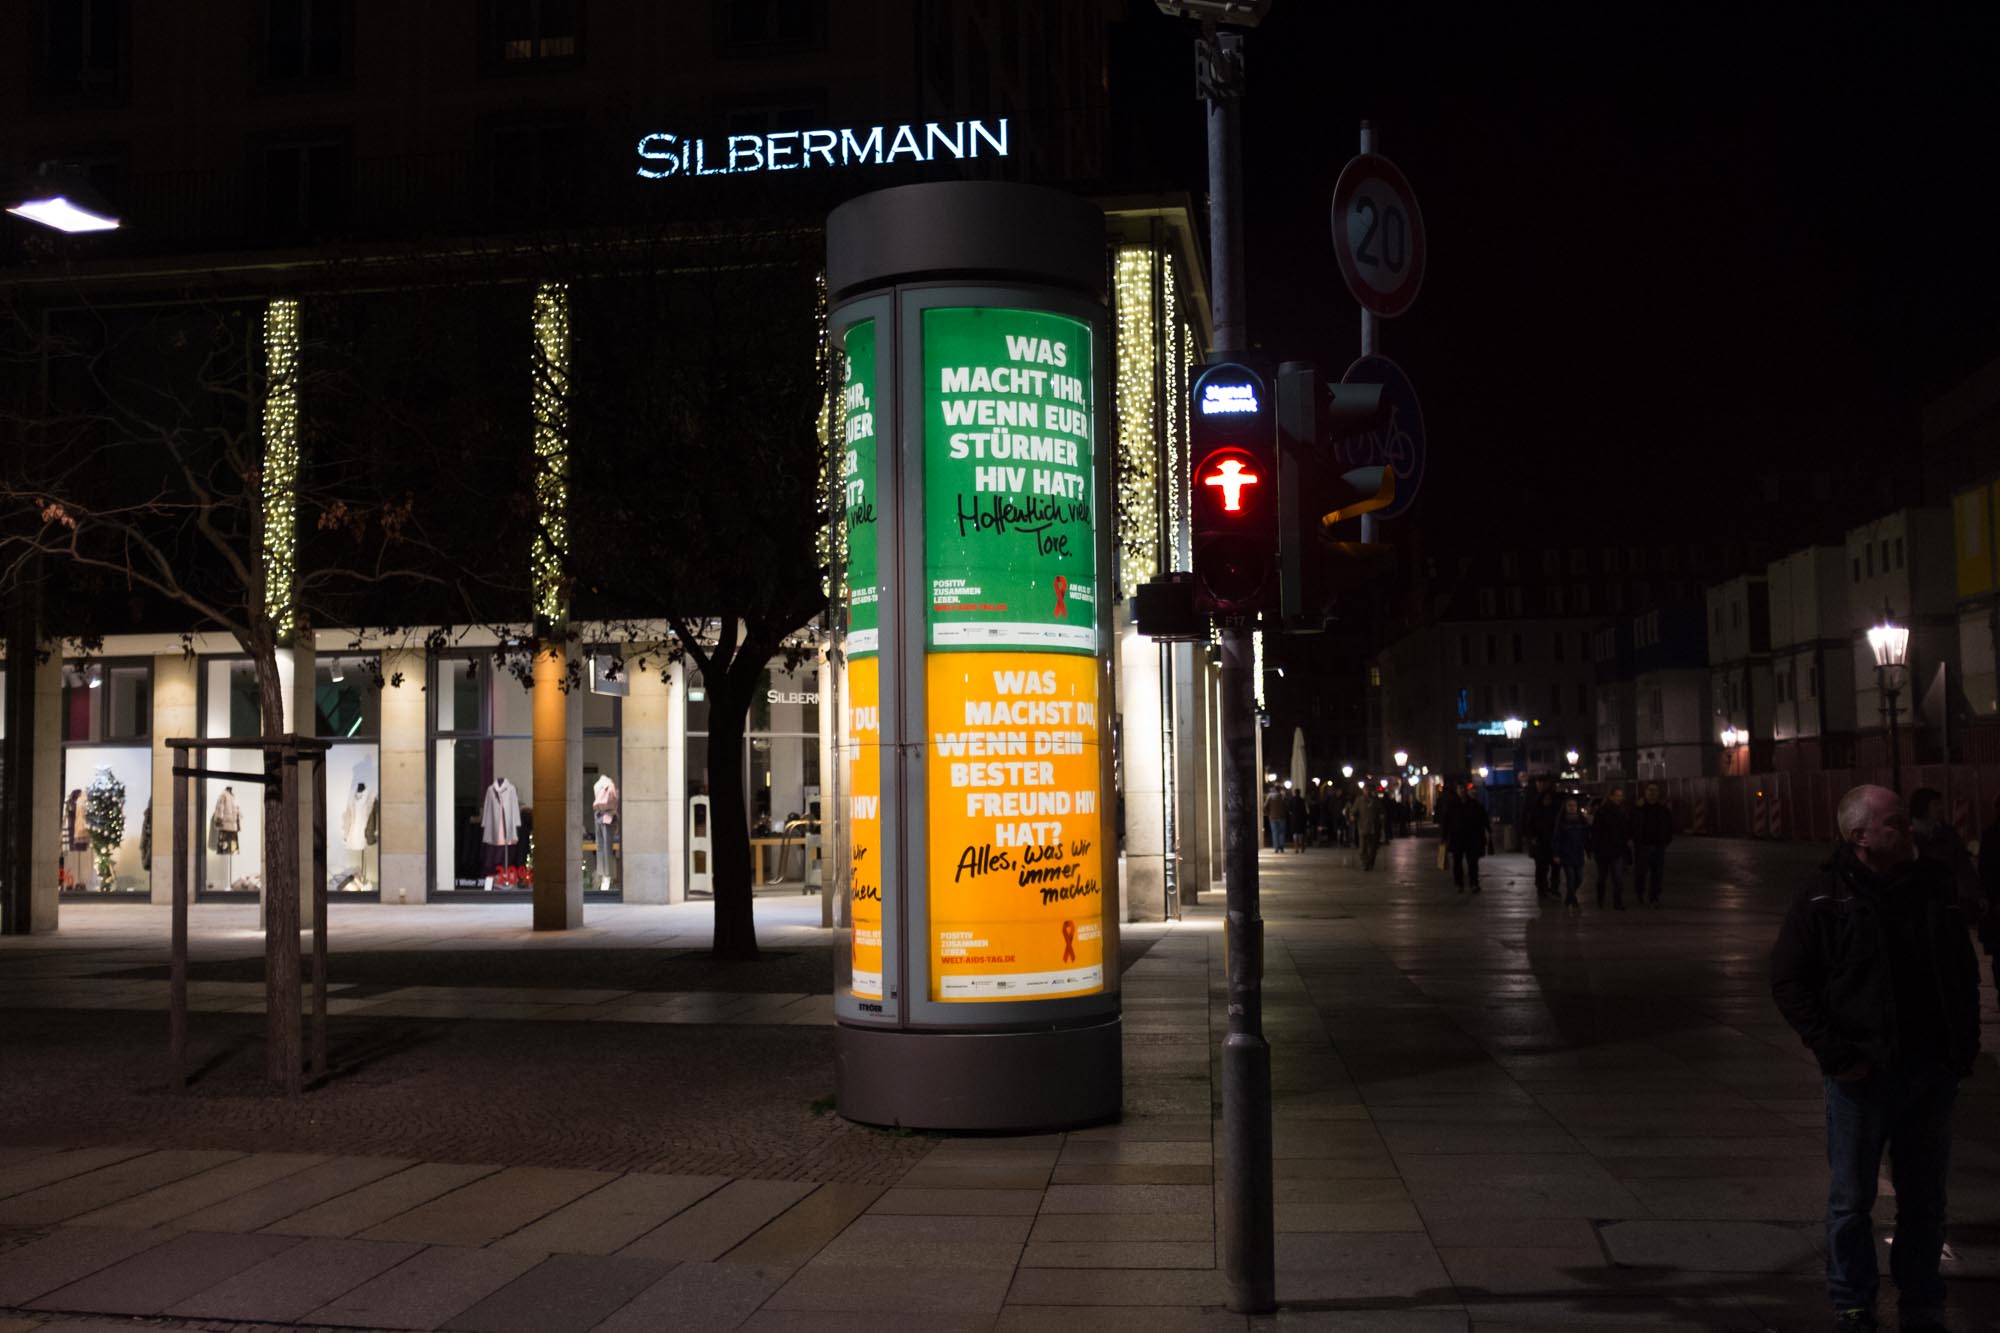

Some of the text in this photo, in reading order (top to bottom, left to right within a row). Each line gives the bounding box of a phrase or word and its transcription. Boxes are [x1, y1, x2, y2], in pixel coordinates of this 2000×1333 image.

[636, 118, 1009, 179] SILBERMANN
[1356, 196, 1405, 273] 20
[1006, 335, 1067, 368] WAS
[941, 367, 1086, 412] MACHT IHR,
[941, 400, 1088, 439] WENN EUER
[950, 427, 1078, 467] STÜRMER
[976, 467, 1084, 499] HIV HAT?
[958, 493, 1067, 537] Hoffentlich
[932, 579, 966, 588] POSITIV
[993, 671, 1056, 695] WAS
[856, 706, 880, 734] DU,
[965, 701, 1071, 726] MACHST
[935, 731, 1083, 757] WENN DEIN
[950, 761, 1055, 787] BESTER
[855, 796, 878, 820] HIV
[967, 790, 1096, 818] FREUND HIV
[995, 821, 1063, 848] HAT?
[955, 843, 1018, 883] Alles,
[1023, 840, 1064, 865] was
[1018, 862, 1081, 887] immer
[941, 955, 1016, 965] WELT-AIDS-TAG.DE
